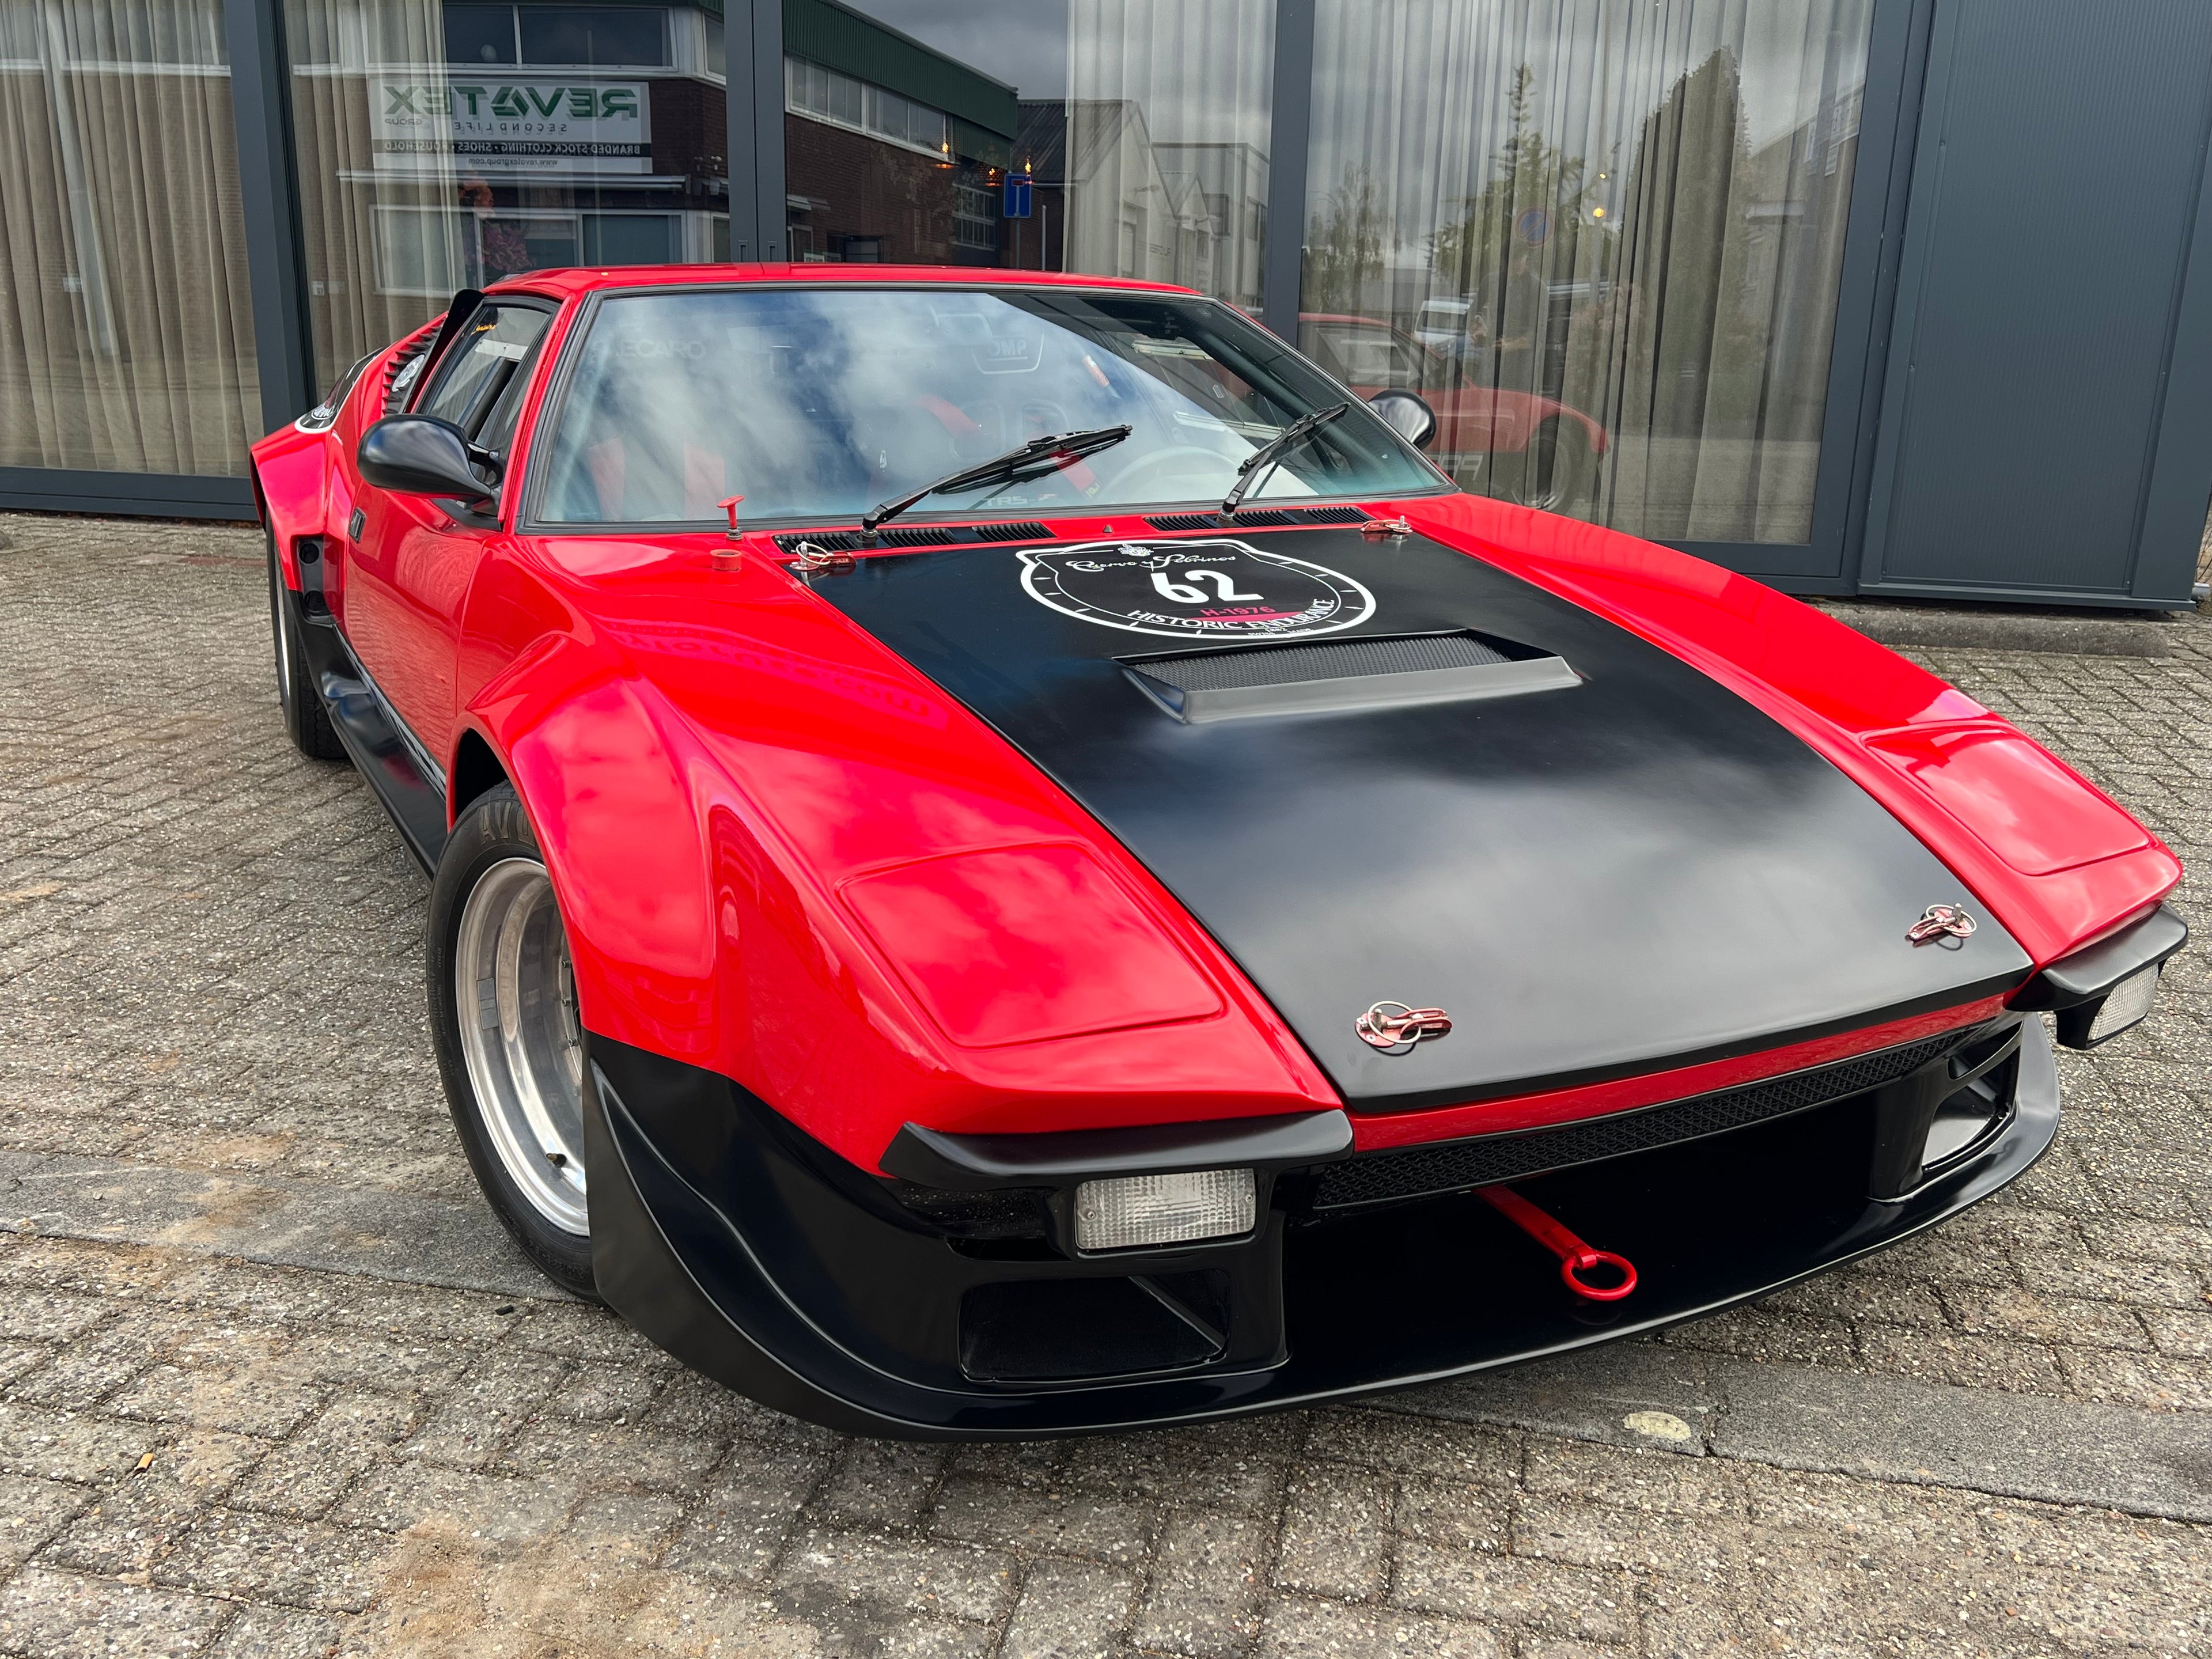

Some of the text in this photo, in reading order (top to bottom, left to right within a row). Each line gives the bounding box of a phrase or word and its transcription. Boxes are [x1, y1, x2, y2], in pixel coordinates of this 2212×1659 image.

[1150, 569, 1264, 604] 62
[1126, 599, 1335, 629] HISTORIC ENDURANCE
[1199, 606, 1277, 617] H-1976
